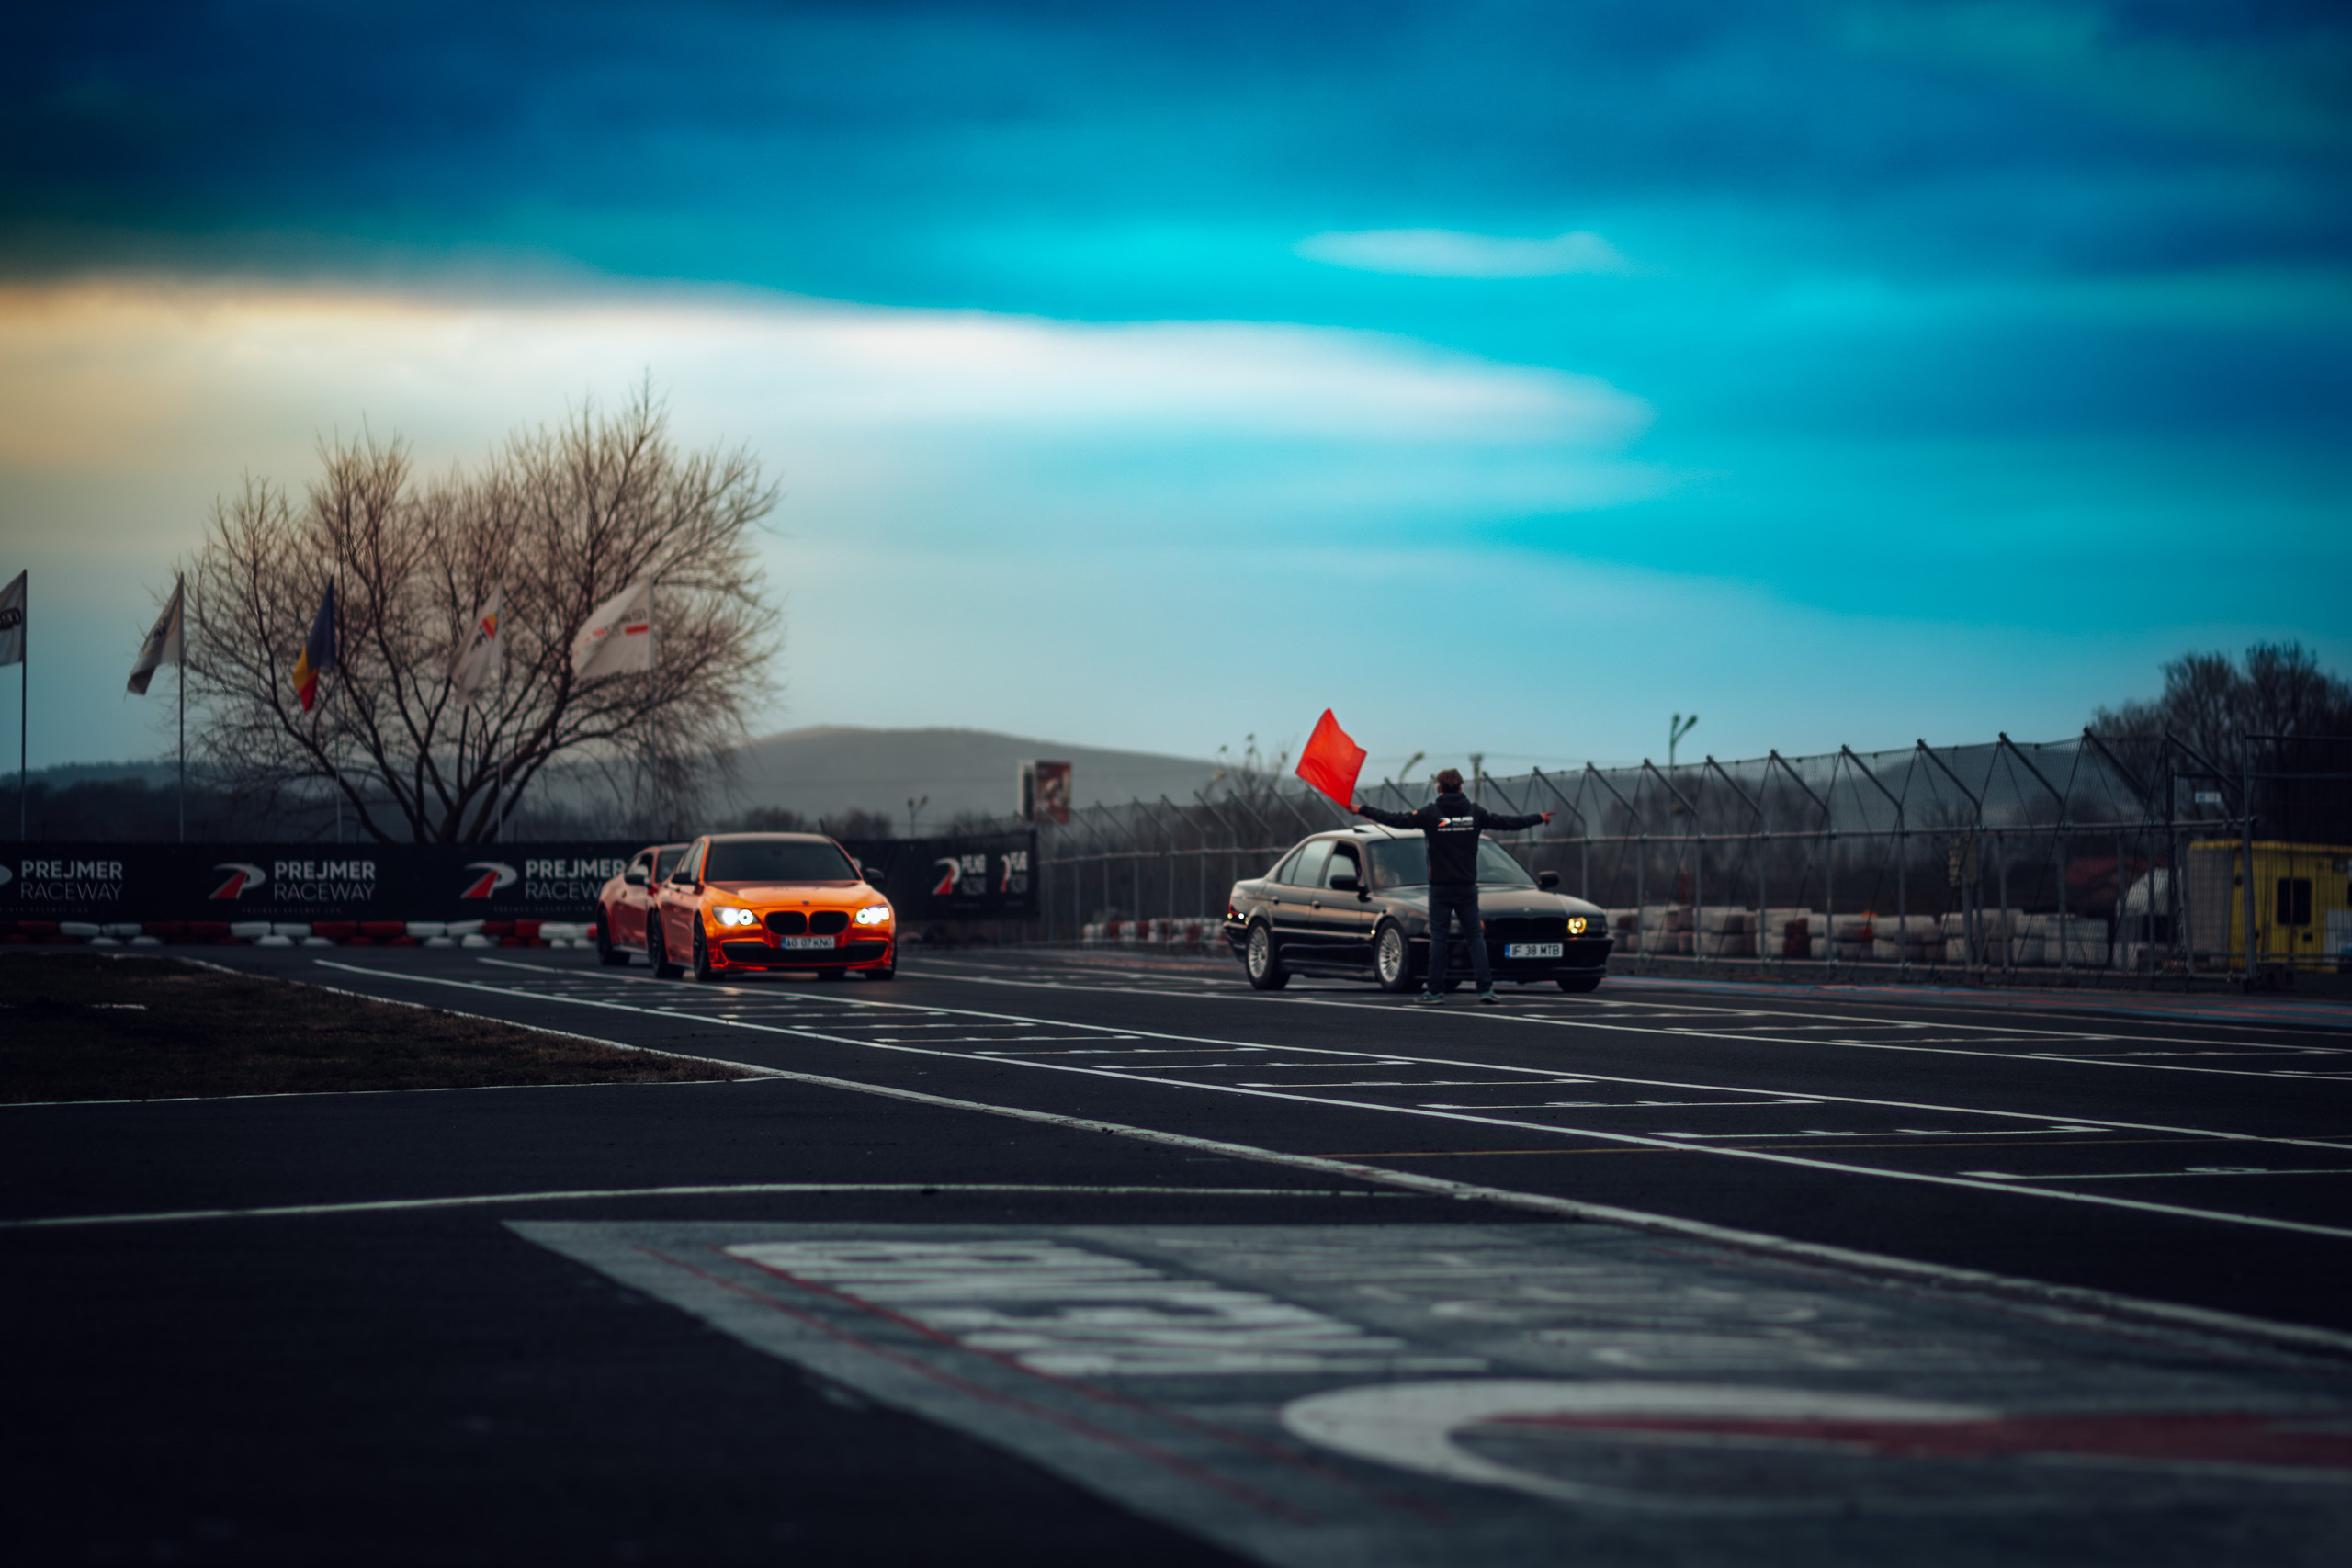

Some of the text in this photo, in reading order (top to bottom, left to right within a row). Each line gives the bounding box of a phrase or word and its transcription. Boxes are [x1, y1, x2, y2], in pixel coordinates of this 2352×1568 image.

[20, 860, 123, 880] PREJMER
[274, 860, 376, 881] PREJMER
[525, 859, 626, 879] PREJMER
[20, 882, 123, 901] RACEWAY
[274, 883, 376, 902] RACEWAY
[525, 881, 602, 901] RACEW
[1512, 945, 1521, 955] IF
[1540, 945, 1560, 955] MTB
